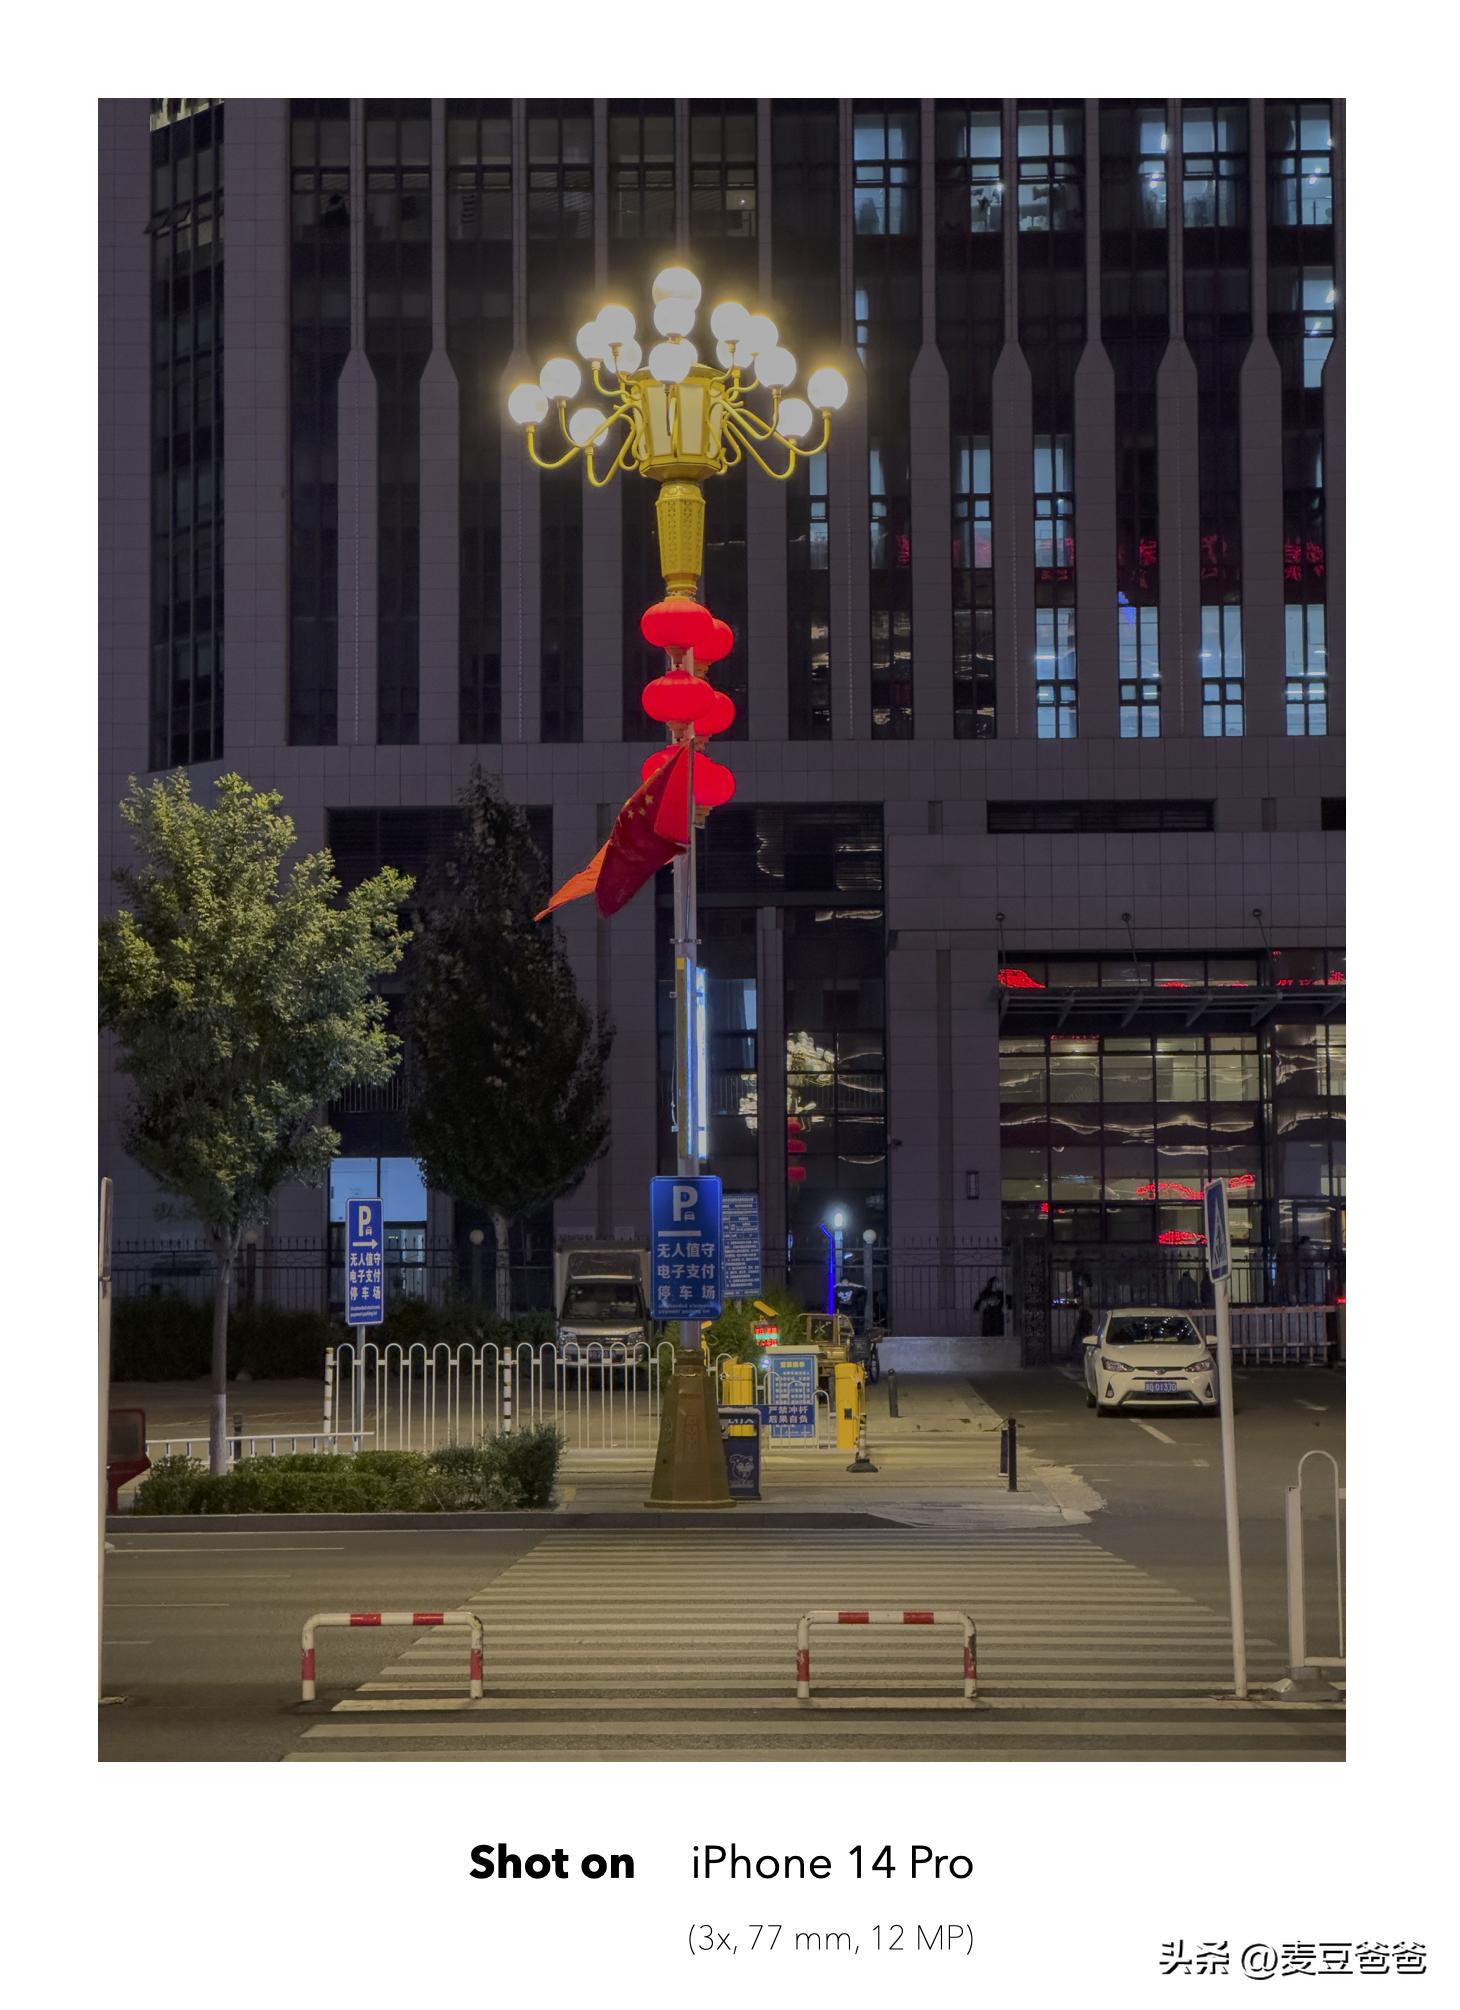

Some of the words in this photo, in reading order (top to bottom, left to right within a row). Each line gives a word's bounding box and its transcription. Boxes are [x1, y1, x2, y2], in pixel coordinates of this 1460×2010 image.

[673, 1185, 699, 1222] P
[358, 1205, 372, 1236] P
[657, 1243, 715, 1258] 无人值守
[350, 1252, 381, 1266] 无人值守
[350, 1269, 381, 1284] 电子支付
[657, 1264, 715, 1279] 电子支付
[350, 1286, 381, 1301] 停车场
[657, 1285, 716, 1301] 停车场
[768, 1415, 809, 1424] 后果自负
